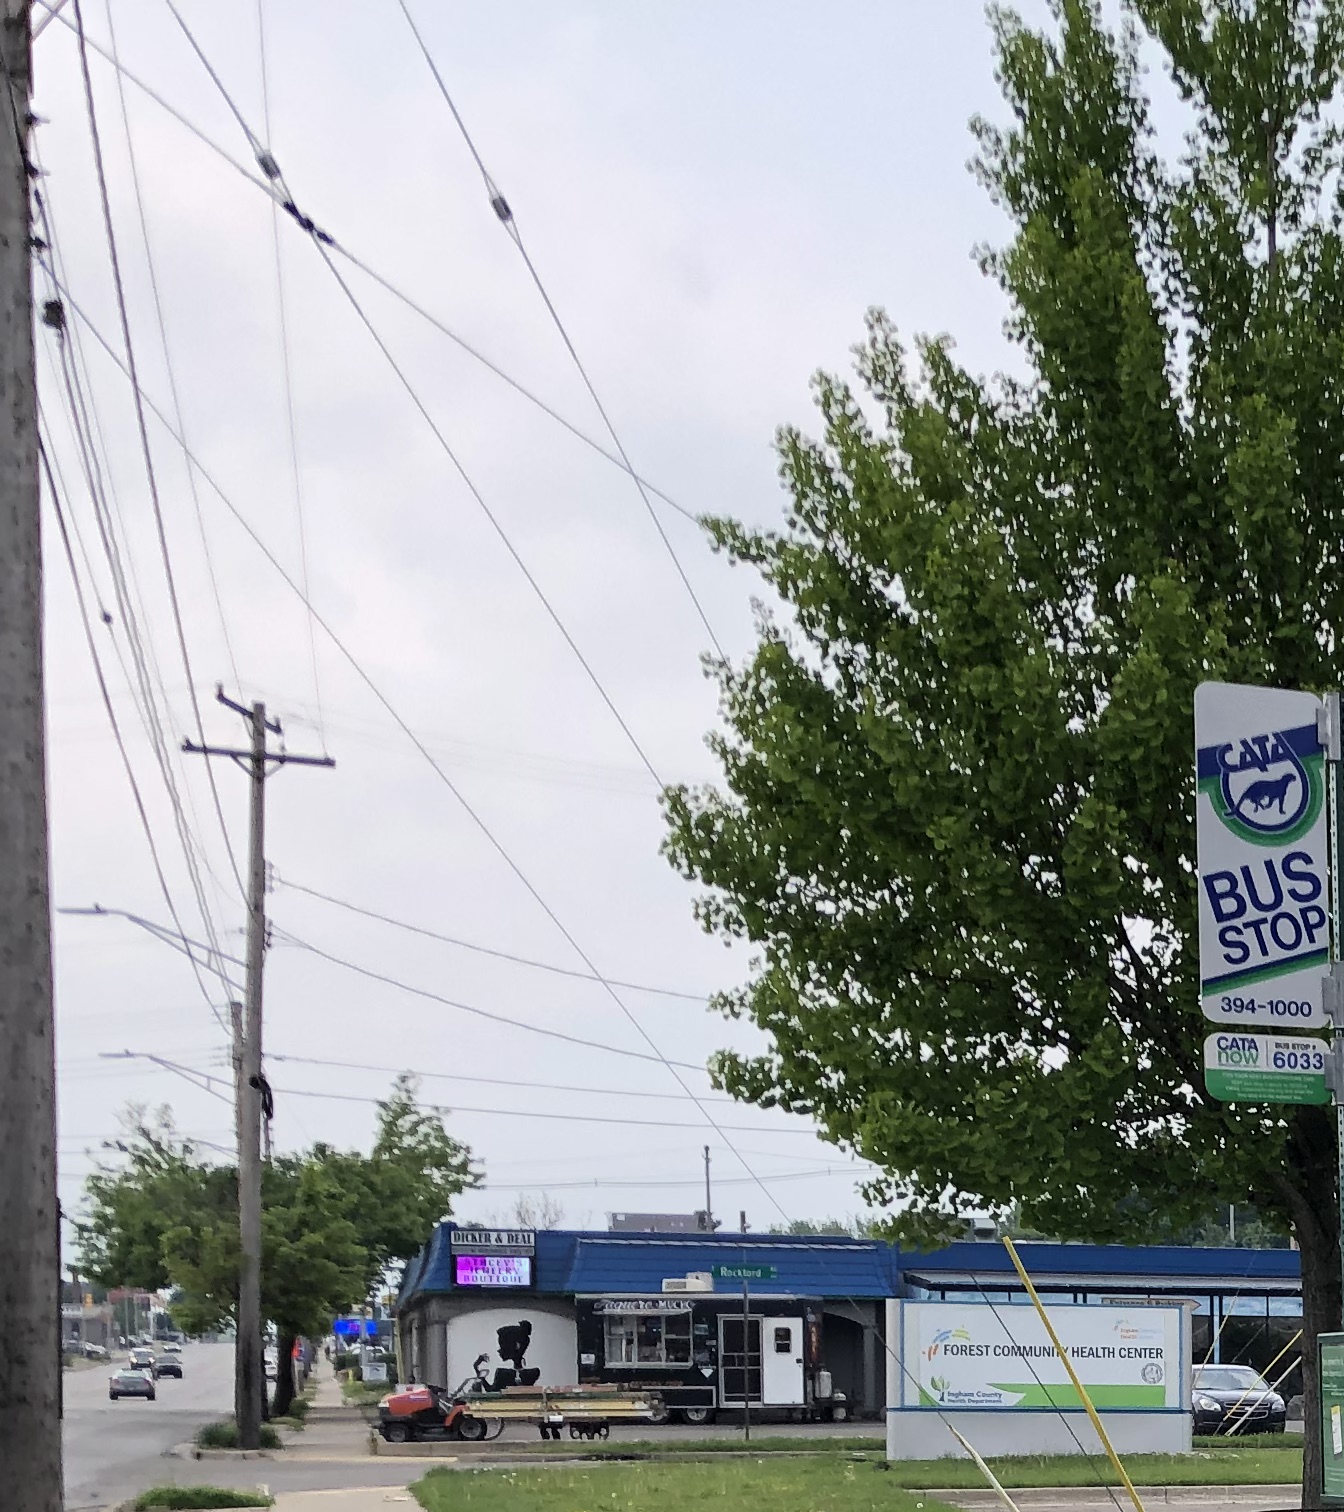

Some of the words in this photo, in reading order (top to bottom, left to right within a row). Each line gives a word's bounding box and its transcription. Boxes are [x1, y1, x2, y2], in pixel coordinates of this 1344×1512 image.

[1217, 731, 1296, 773] CATA
[1202, 851, 1322, 924] BUS
[1218, 905, 1326, 965] STOP
[1220, 997, 1312, 1018] 394-1000
[1216, 1036, 1258, 1052] CATA
[1217, 1050, 1259, 1065] now
[1273, 1051, 1324, 1070] 6033
[453, 1231, 491, 1244] DICKER
[494, 1233, 503, 1244] &
[507, 1233, 533, 1244] DEAL
[944, 1344, 990, 1357] FOREST
[1072, 1346, 1115, 1358] HEALTH
[1119, 1347, 1164, 1359] CENTER
[947, 1391, 975, 1399] Ingham
[976, 1391, 1003, 1400] County
